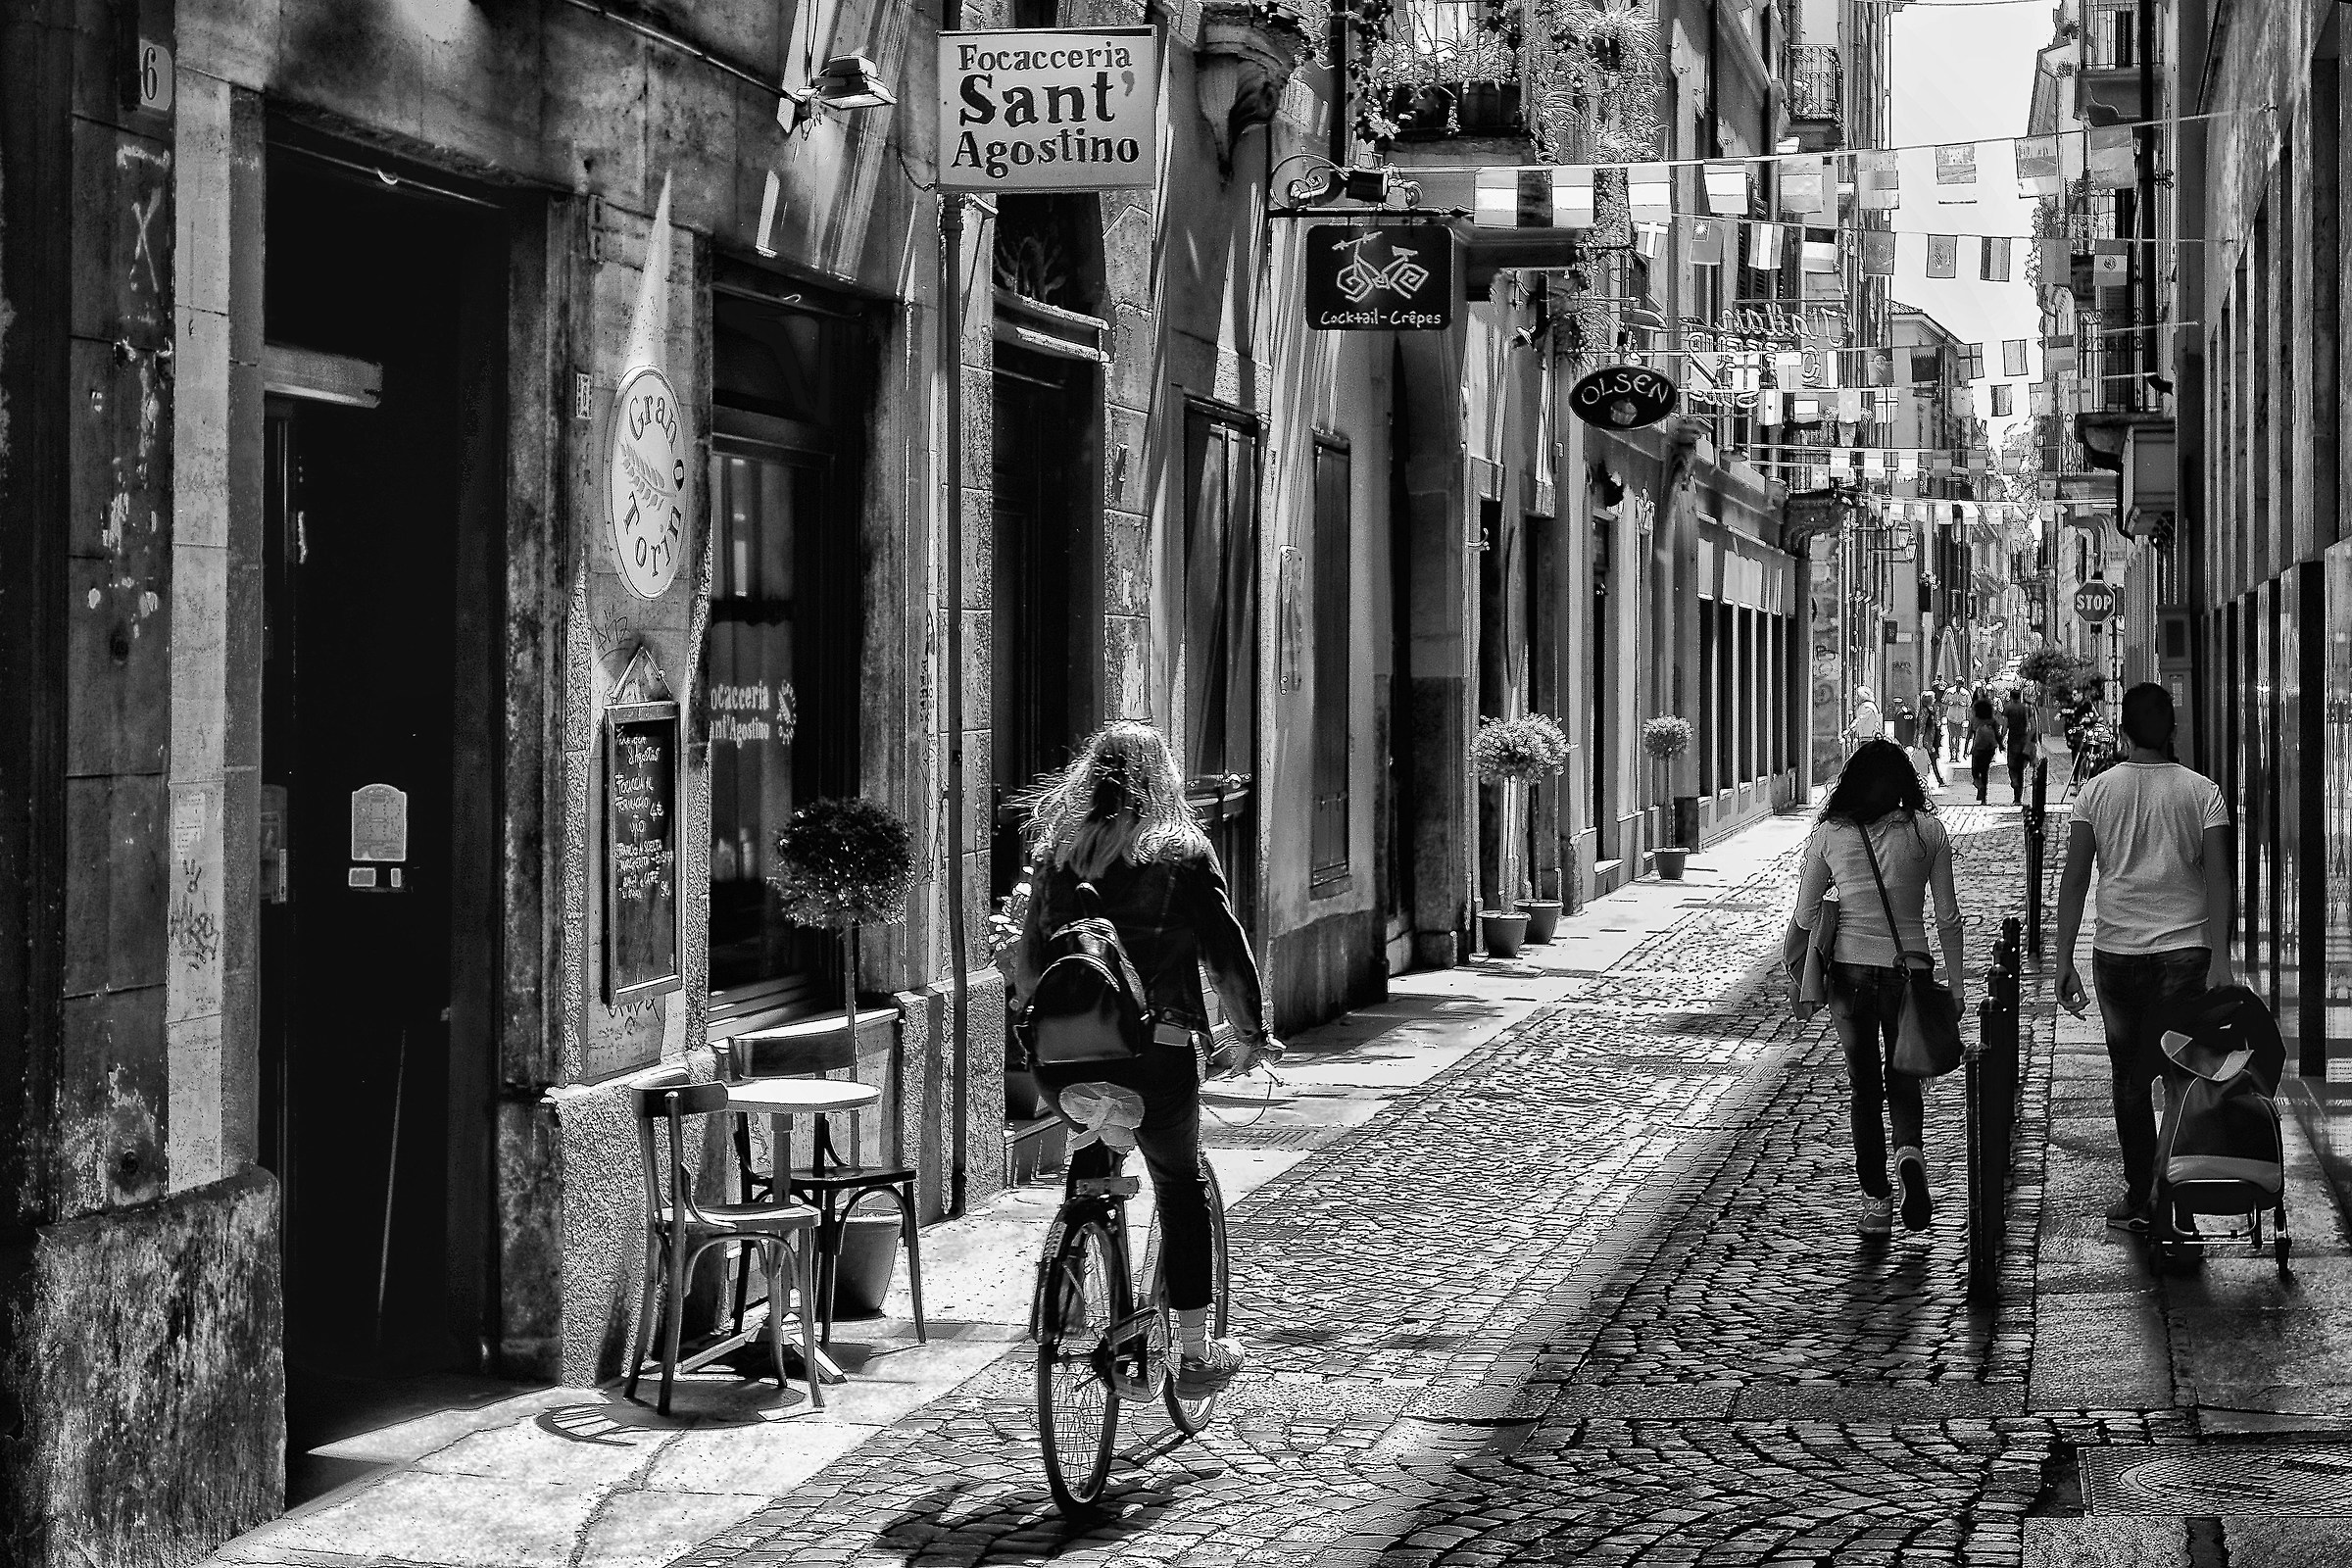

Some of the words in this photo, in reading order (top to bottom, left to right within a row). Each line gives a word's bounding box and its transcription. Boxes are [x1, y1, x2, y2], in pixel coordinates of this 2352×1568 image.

[142, 46, 157, 100] 6
[957, 41, 1132, 71] Focacceria
[959, 70, 1135, 127] Sant'
[951, 127, 1140, 179] Agostino
[1582, 373, 1669, 404] OLSEN
[628, 394, 678, 455] Gran
[623, 458, 685, 577] Torino
[2077, 594, 2113, 611] STOP
